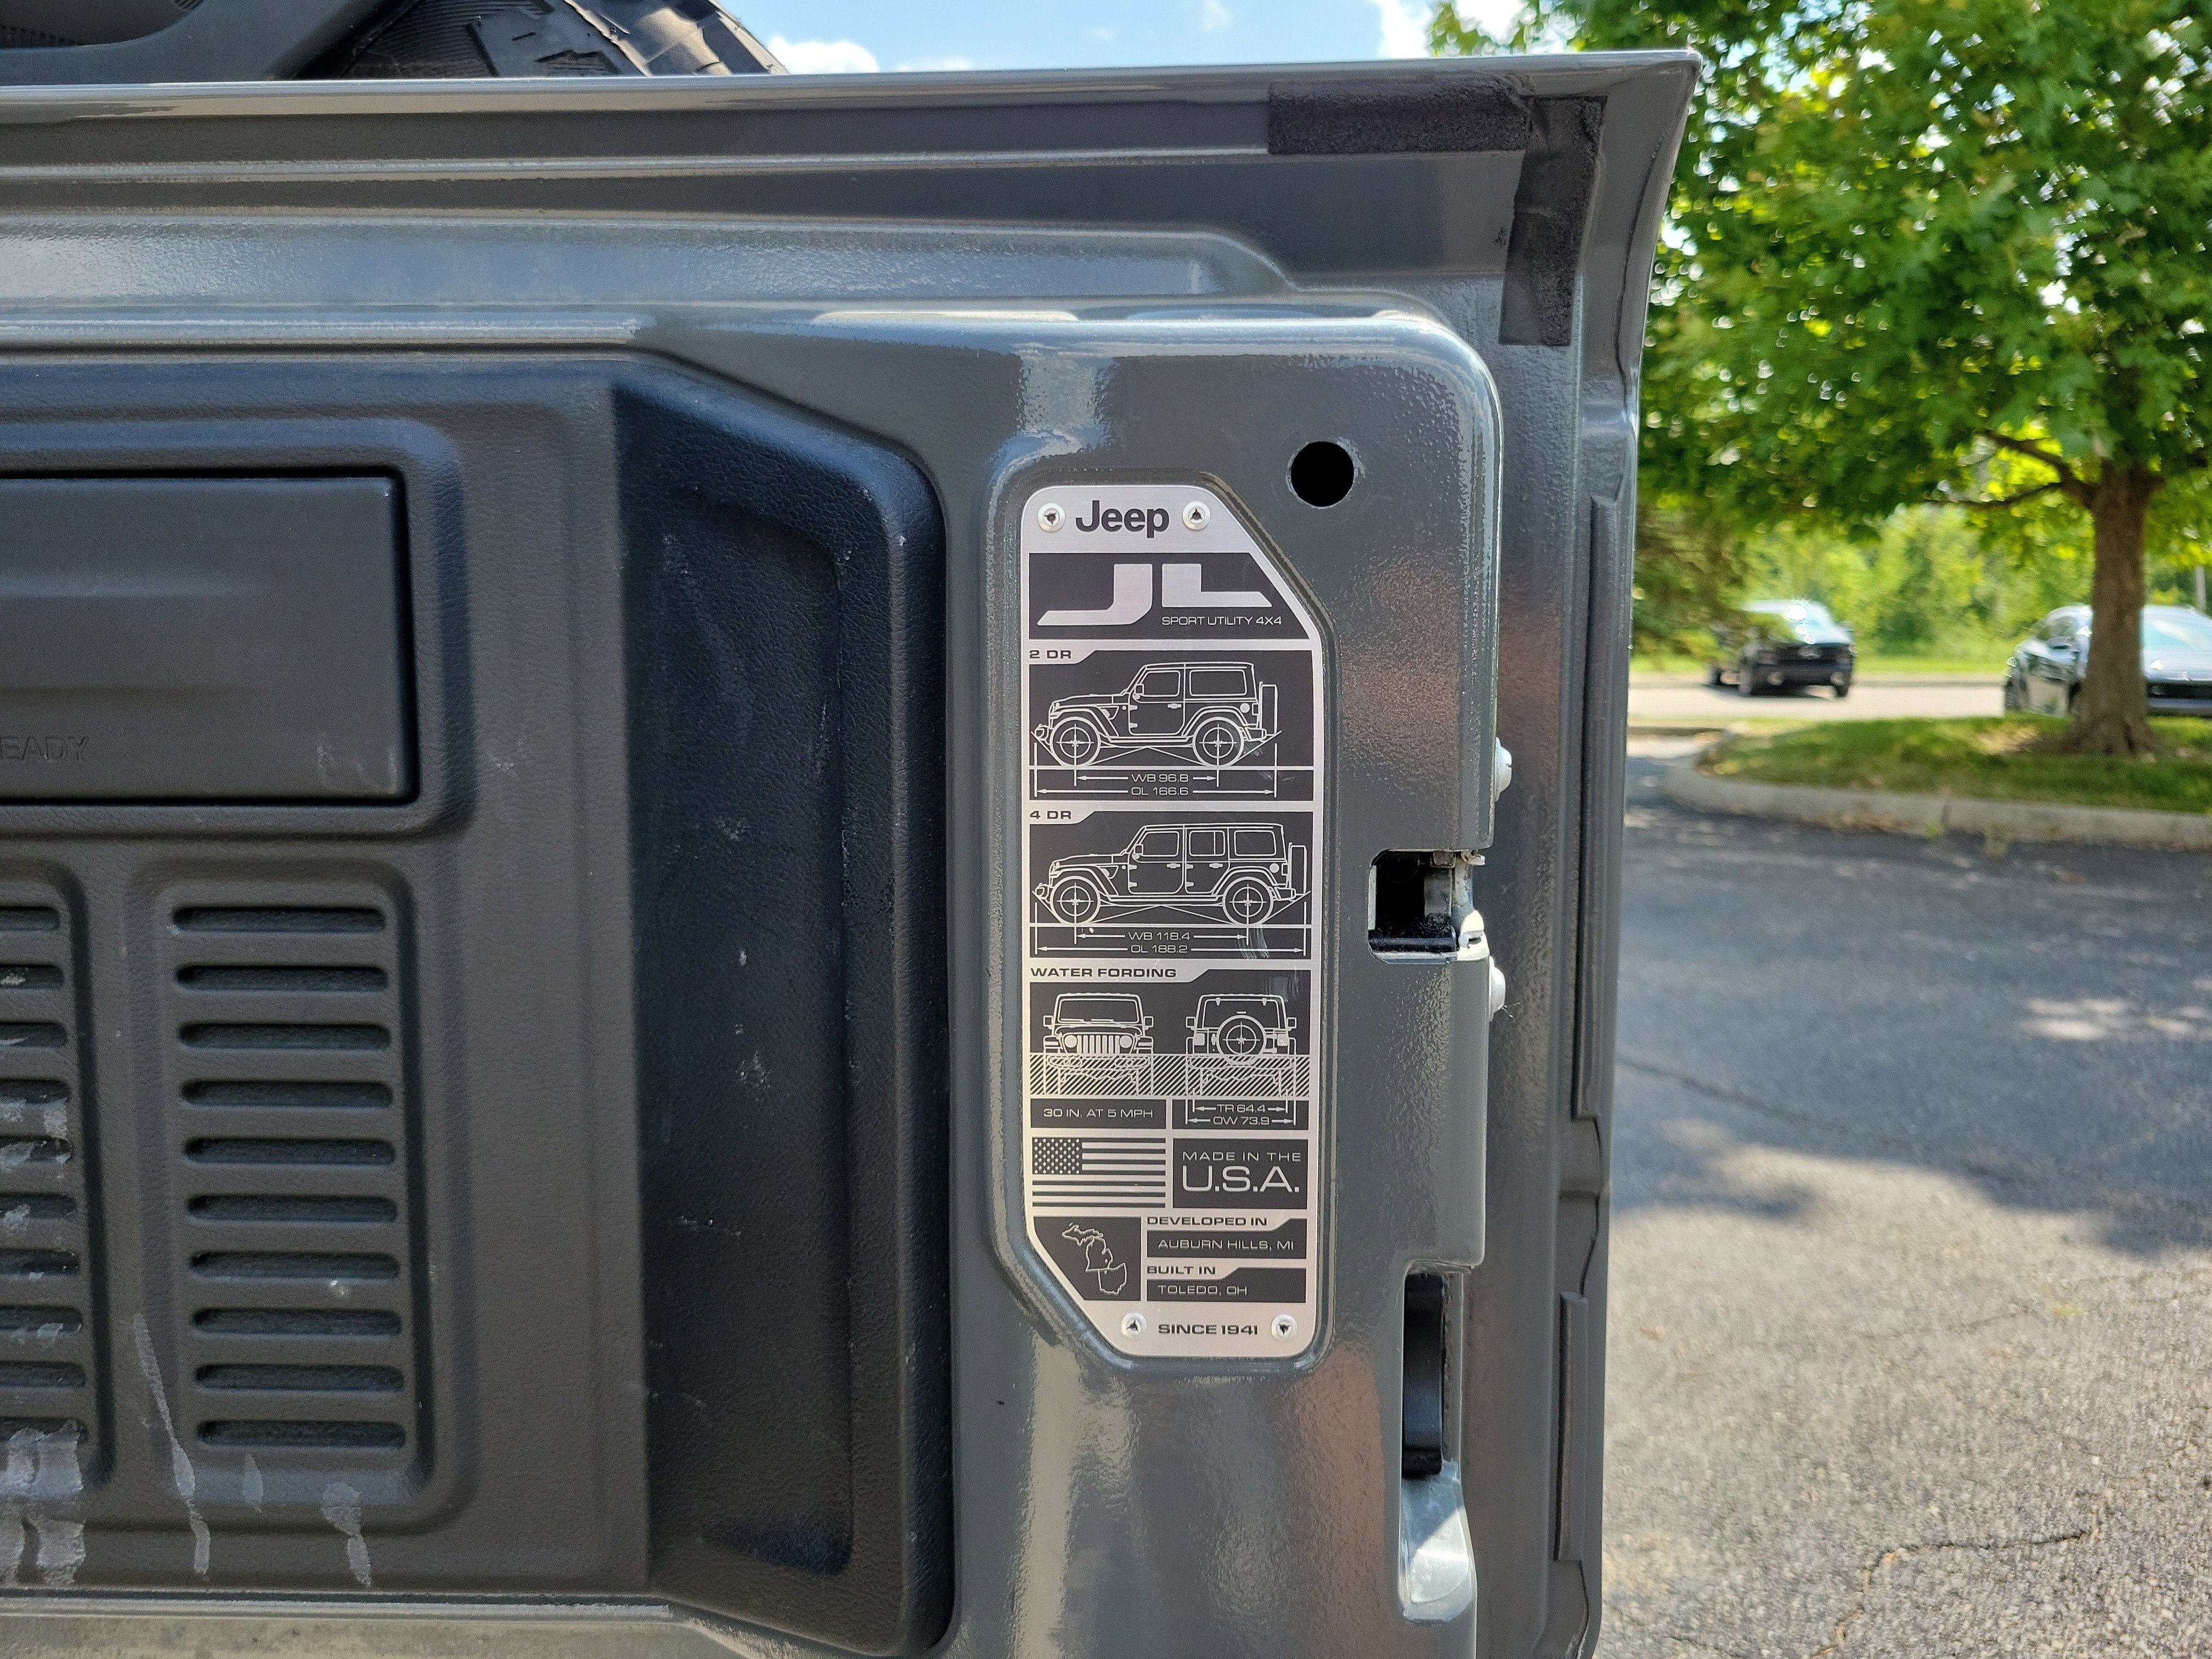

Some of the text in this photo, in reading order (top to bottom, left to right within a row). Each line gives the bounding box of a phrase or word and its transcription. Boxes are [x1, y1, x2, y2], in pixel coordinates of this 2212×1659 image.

[1075, 500, 1170, 539] Jeep
[1036, 563, 1273, 627] JL
[1162, 616, 1282, 625] SPORT UTILITY 4X4
[1029, 650, 1071, 659] 2 DR
[1131, 774, 1189, 782] WB 96.8
[1131, 787, 1189, 795] OL 166.6
[1029, 810, 1071, 820] 4 DR
[1128, 932, 1190, 941] WB 118.4
[1131, 945, 1188, 953] OL 188.2
[1030, 968, 1176, 978] WATER FORDING
[1043, 1108, 1153, 1118] 30 IN. AT 5 MPH
[1216, 1104, 1266, 1113] TR 64.4
[1213, 1116, 1269, 1125] OW 73.9
[1183, 1152, 1301, 1162] MADE IN THE
[1182, 1165, 1300, 1193] U.S.A.
[1147, 1216, 1267, 1226] DEVELOPED IN
[1158, 1239, 1294, 1251] AUBURN HILLS, MI
[1147, 1266, 1216, 1275] BUILT IN
[1158, 1285, 1247, 1296] TOLEDO, OH
[1158, 1324, 1258, 1335] SINCE 1941
